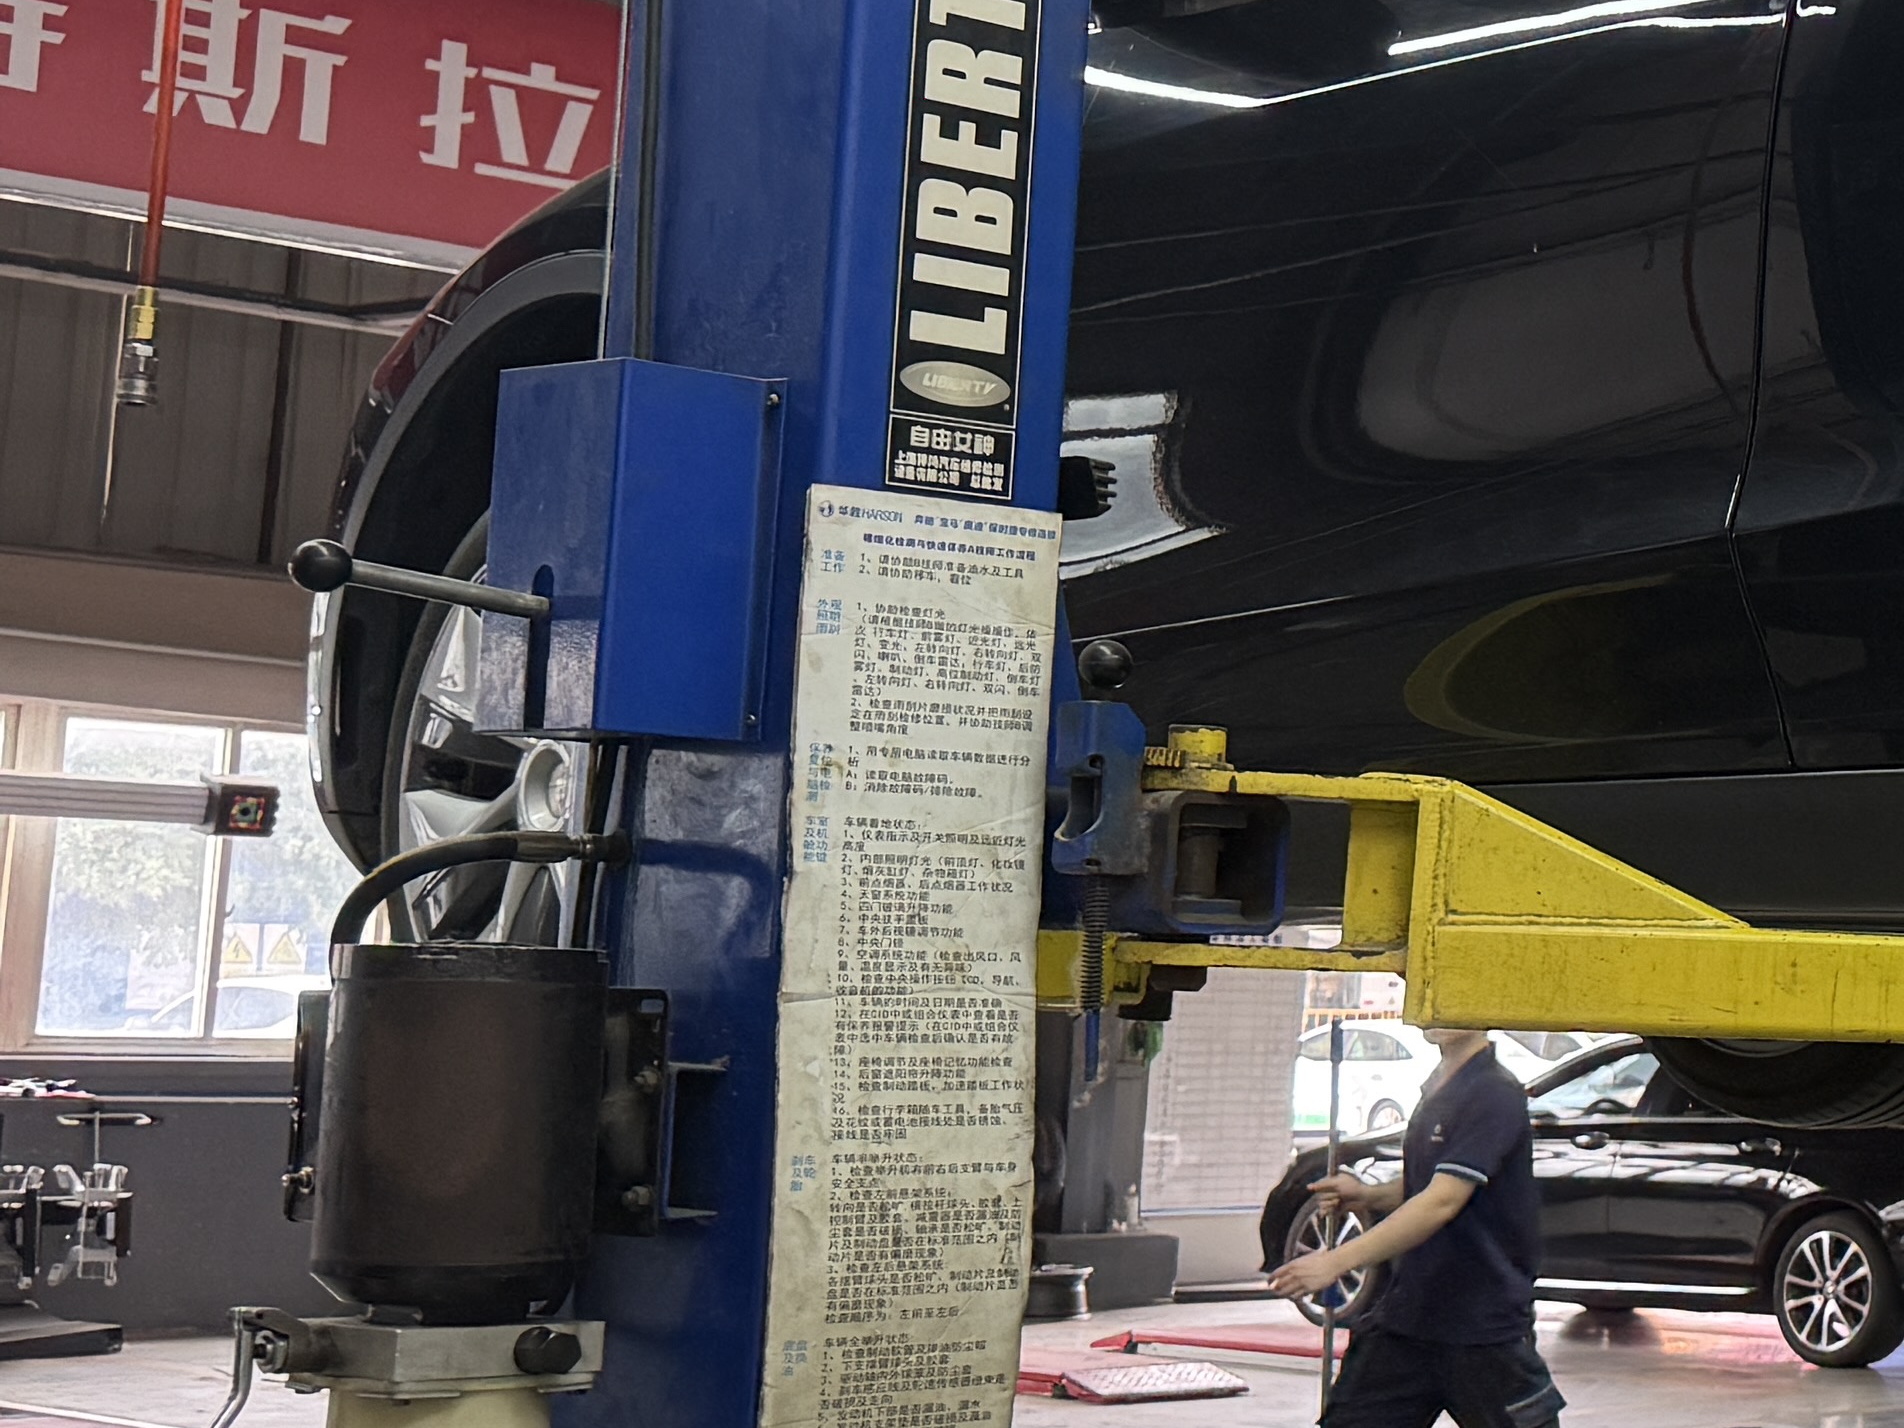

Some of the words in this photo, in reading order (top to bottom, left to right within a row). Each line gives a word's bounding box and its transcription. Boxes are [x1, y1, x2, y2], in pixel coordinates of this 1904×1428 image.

[922, 372, 998, 395] LIBERTY
[910, 425, 995, 456] 自由女神
[822, 550, 845, 561] 准备
[820, 561, 845, 572] 工作
